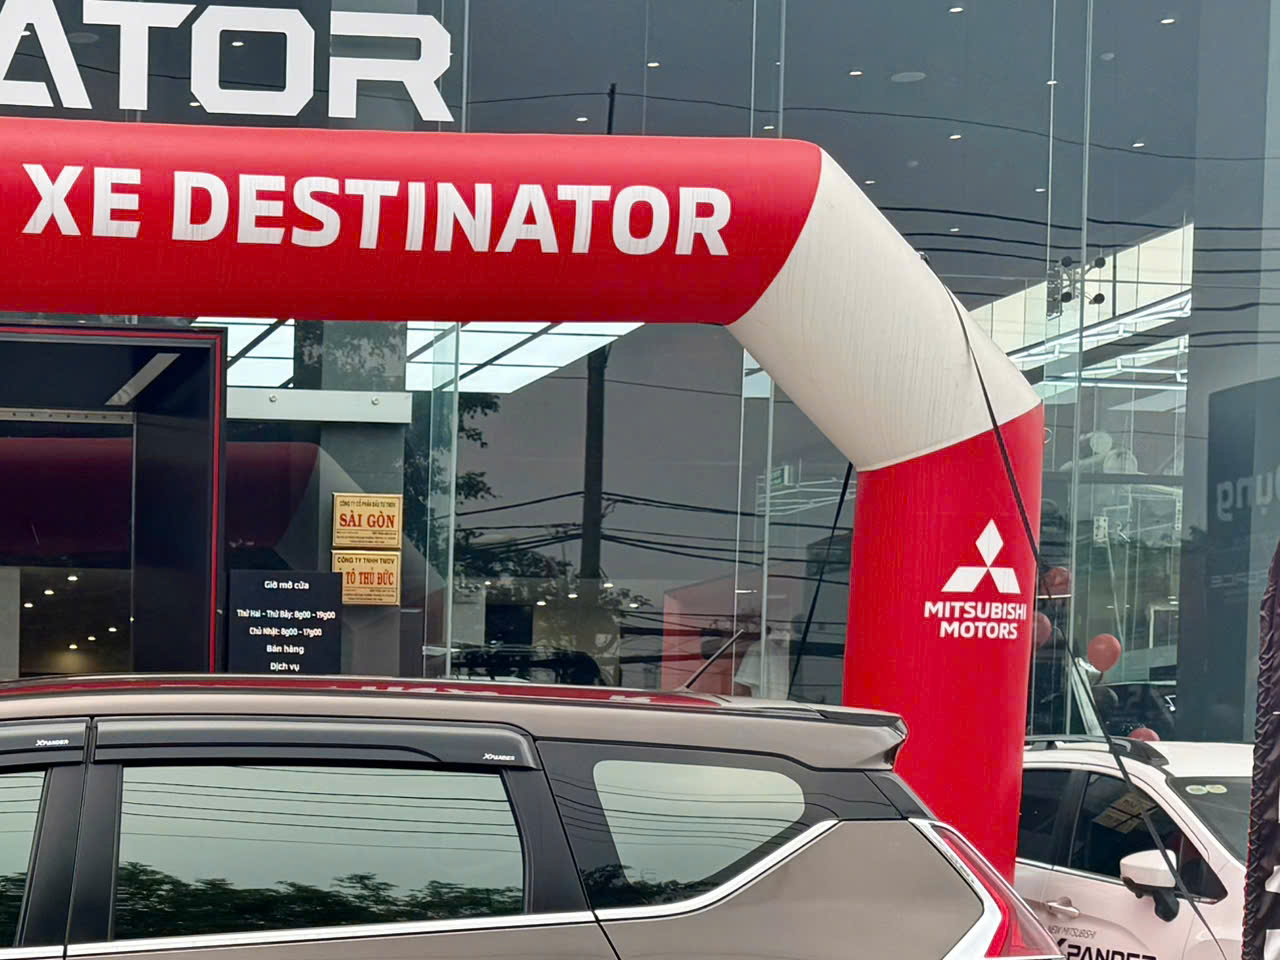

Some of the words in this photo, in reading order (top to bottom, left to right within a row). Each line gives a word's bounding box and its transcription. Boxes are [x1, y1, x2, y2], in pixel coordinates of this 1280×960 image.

[22, 163, 142, 239] XE
[172, 170, 732, 256] DESTINATOR
[339, 510, 362, 528] SÀI
[367, 511, 395, 529] GÒN
[924, 601, 1027, 620] MITSUBISHI
[939, 621, 1018, 640] MOTORS
[270, 662, 289, 672] Dịch
